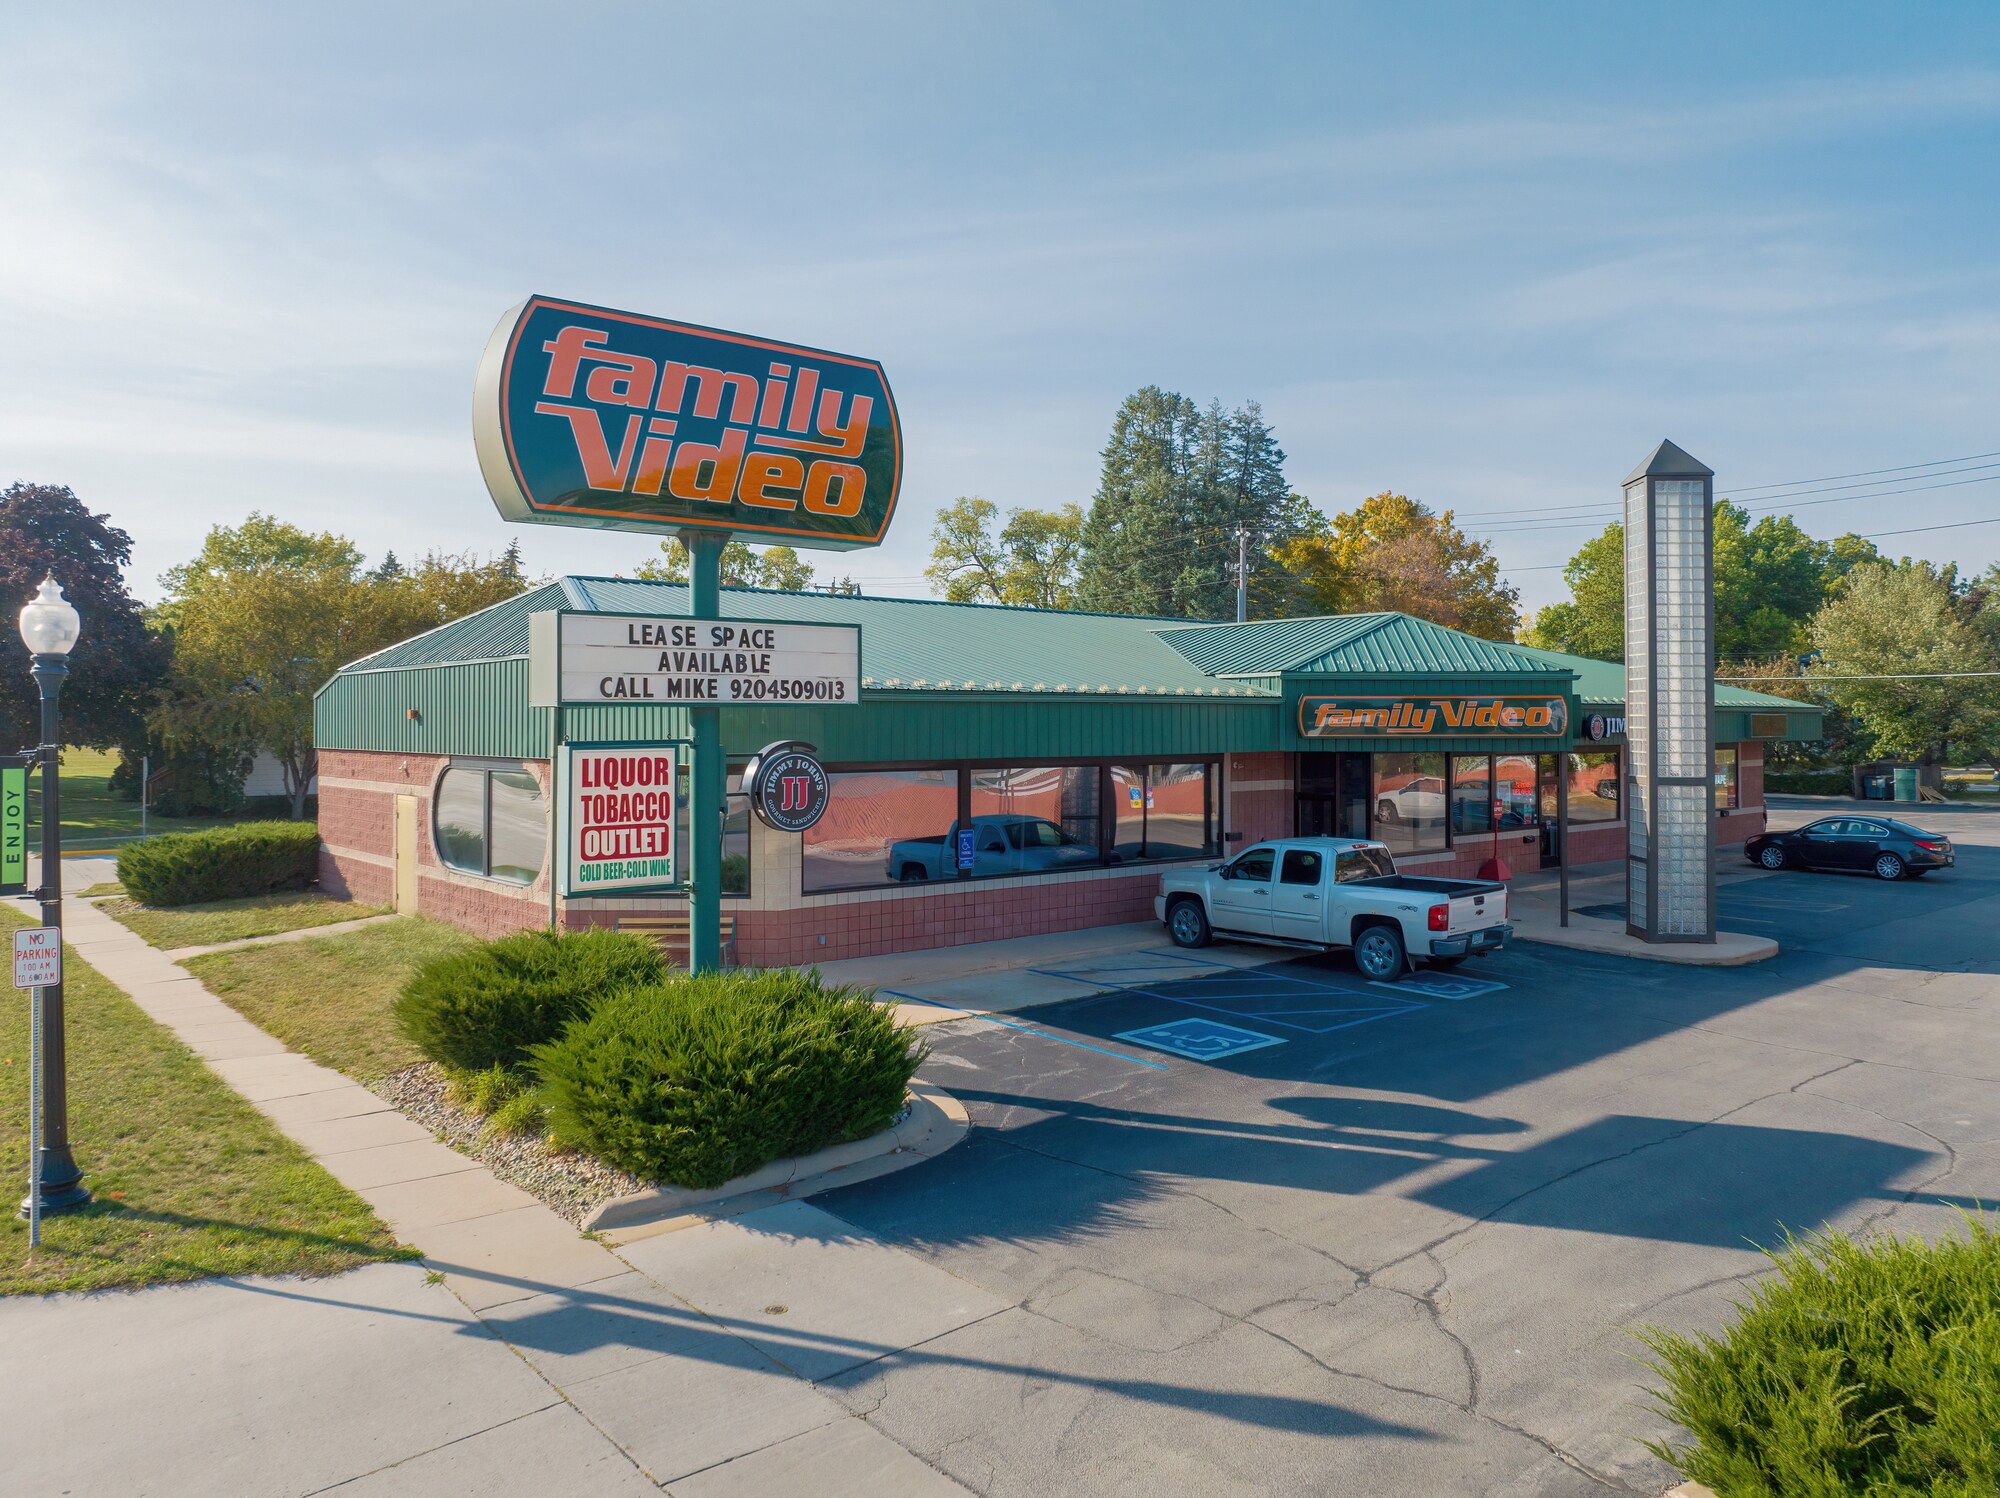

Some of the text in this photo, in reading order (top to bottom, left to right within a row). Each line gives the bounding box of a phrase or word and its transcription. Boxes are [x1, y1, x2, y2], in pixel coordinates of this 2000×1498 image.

[542, 325, 874, 459] family
[534, 401, 867, 518] Video
[628, 624, 775, 649] LEASE SPACE
[658, 652, 770, 673] AVAILABLE
[600, 676, 845, 700] CALL MIKE 9204509013
[1314, 701, 1553, 733] family Video
[1606, 717, 1627, 737] JIM
[581, 757, 669, 790] LIQUOR
[767, 760, 824, 793] JIMMY JOHN'S
[781, 775, 810, 810] JJ
[581, 791, 670, 825] TOBACCO
[768, 797, 823, 825] GOURMET SANDWICHES
[6, 790, 20, 864] ENJOY
[585, 826, 666, 857] OUTLET
[579, 863, 602, 882] COLD
[649, 858, 670, 876] WINE
[29, 933, 45, 945] NO
[16, 948, 57, 961] PARKING
[40, 962, 50, 970] AM
[18, 974, 26, 982] TO
